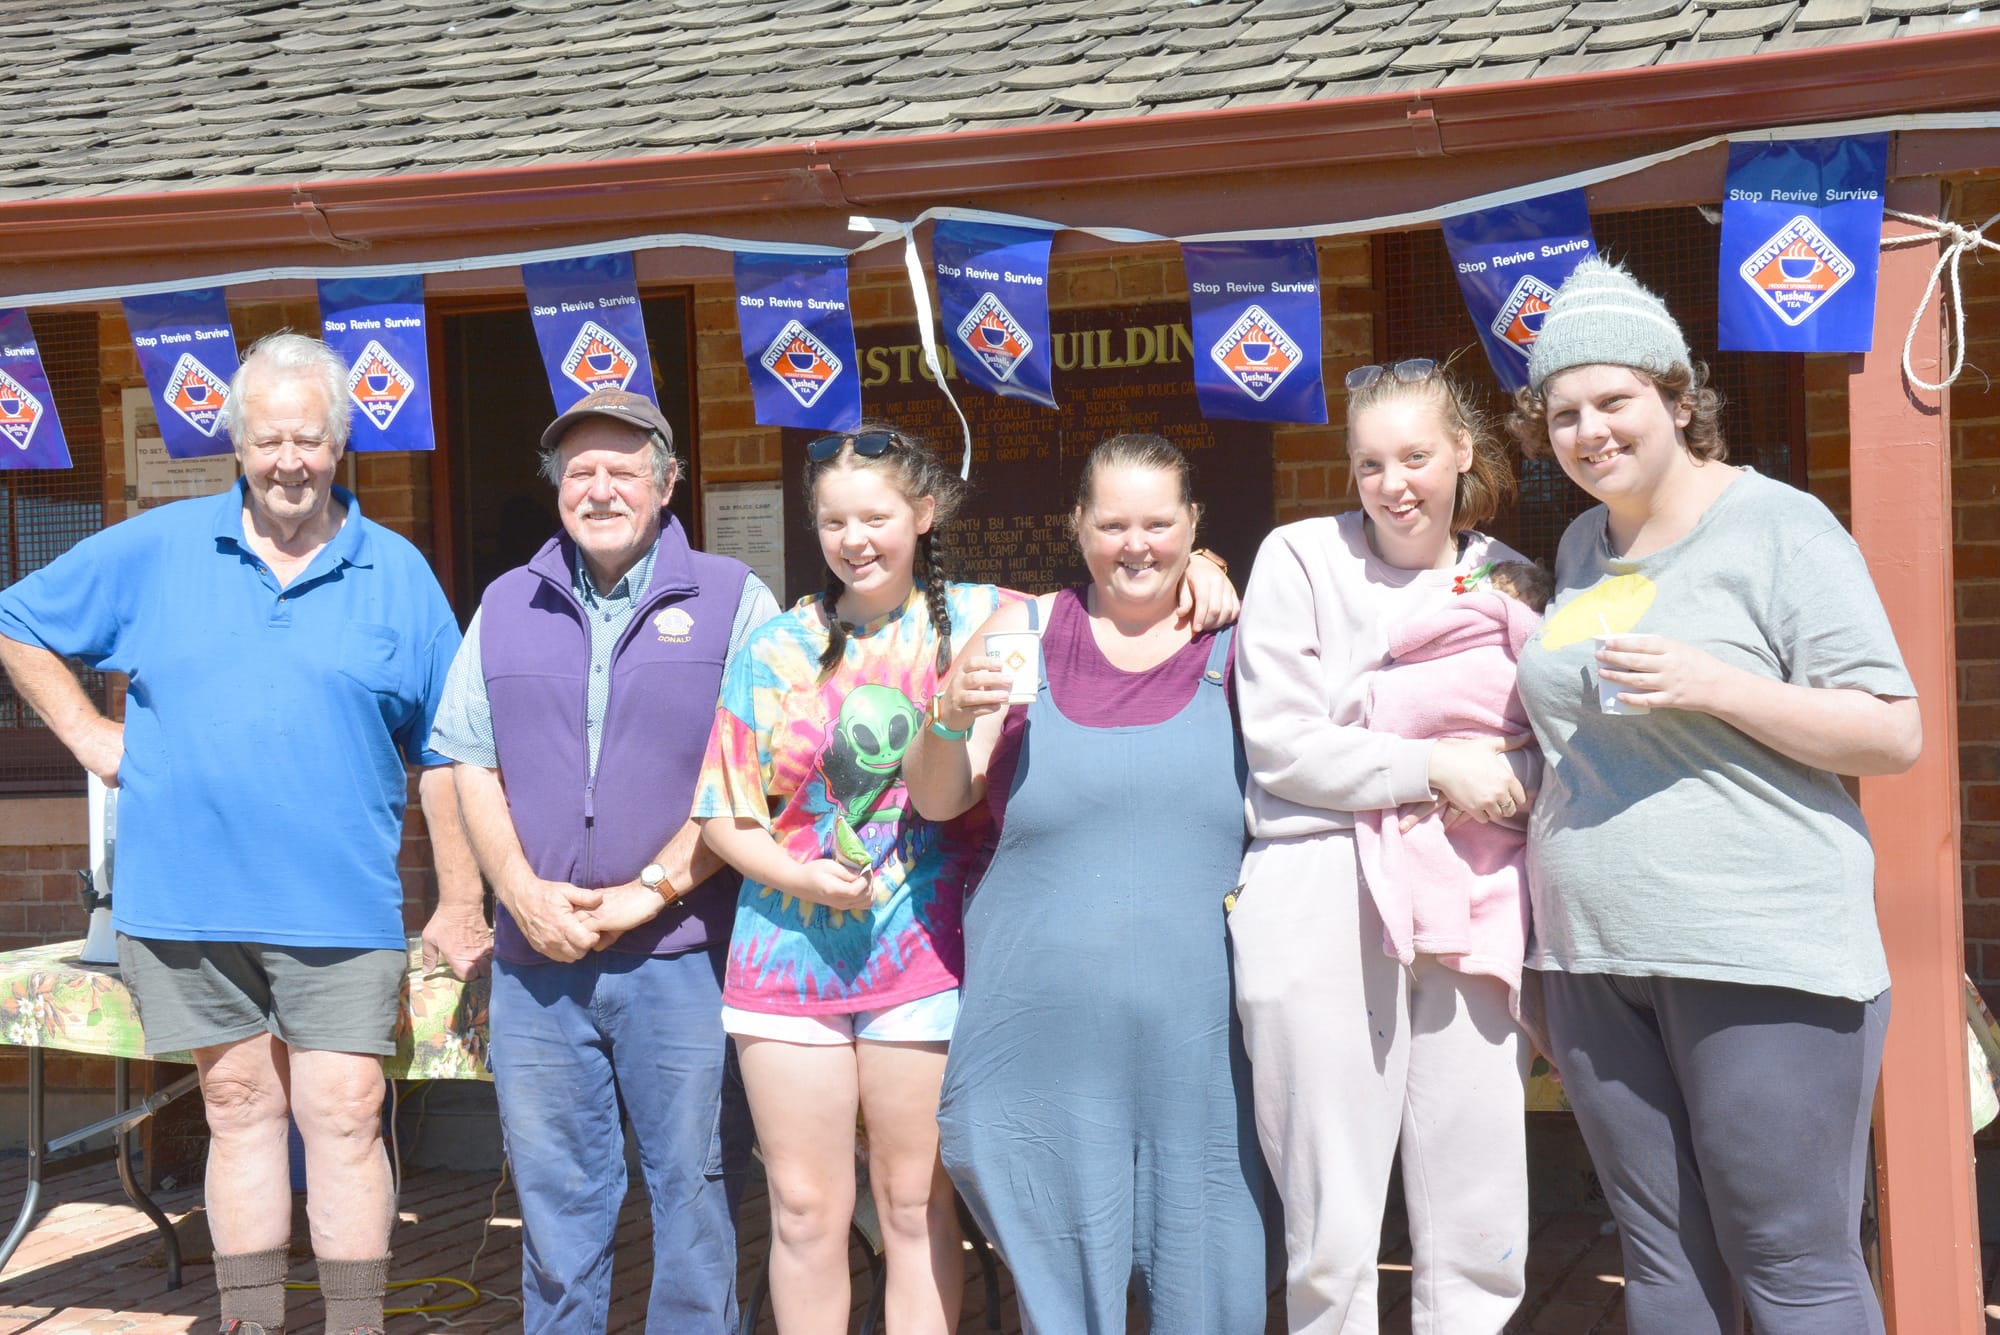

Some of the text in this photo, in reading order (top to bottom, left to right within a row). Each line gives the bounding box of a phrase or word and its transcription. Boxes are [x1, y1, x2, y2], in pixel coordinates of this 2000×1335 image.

[1729, 188, 1878, 203] Stop Revive Survive
[1458, 239, 1589, 273] Stop Revive Survive
[1746, 221, 1849, 278] DRIVER REVIVER
[938, 264, 1043, 285] Stop Revive Survive
[1193, 282, 1314, 294] Stop Revive Survive
[740, 295, 845, 310] Stop Revive Survive
[1775, 291, 1815, 304] Bushells
[534, 295, 636, 316] Stop Revive Survive
[1497, 290, 1530, 334] DRIVER
[325, 317, 421, 332] Stop Revive Survive
[962, 298, 1028, 349] DRIVER REVIVER
[136, 328, 230, 347] Stop Revive Survive
[1217, 310, 1298, 362] DRIVER REVIVER
[5, 346, 35, 357] Survive
[567, 326, 633, 373] DRIVER REVIVER
[765, 325, 837, 371] DRIVER REVIVER
[1051, 323, 1195, 371] UILDIN
[348, 345, 410, 390] DRIVER REVIVER
[167, 357, 228, 403] DRIVER REVIVER
[1241, 372, 1273, 383] Bushells
[942, 411, 975, 424] USIG
[994, 419, 1055, 433] COMMITTEE
[1066, 431, 1096, 442] LIONS
[988, 517, 1004, 529] BY
[1014, 516, 1035, 528] THE
[1044, 514, 1072, 527] RIVE
[966, 533, 978, 544] TO
[984, 530, 1025, 543] PRESENT
[1031, 529, 1051, 541] SITE
[951, 542, 1069, 558] POLICE CAMP ON THIS
[1008, 557, 1028, 569] HUT
[1010, 570, 1055, 583] STABLES
[657, 635, 692, 643] DONALD
